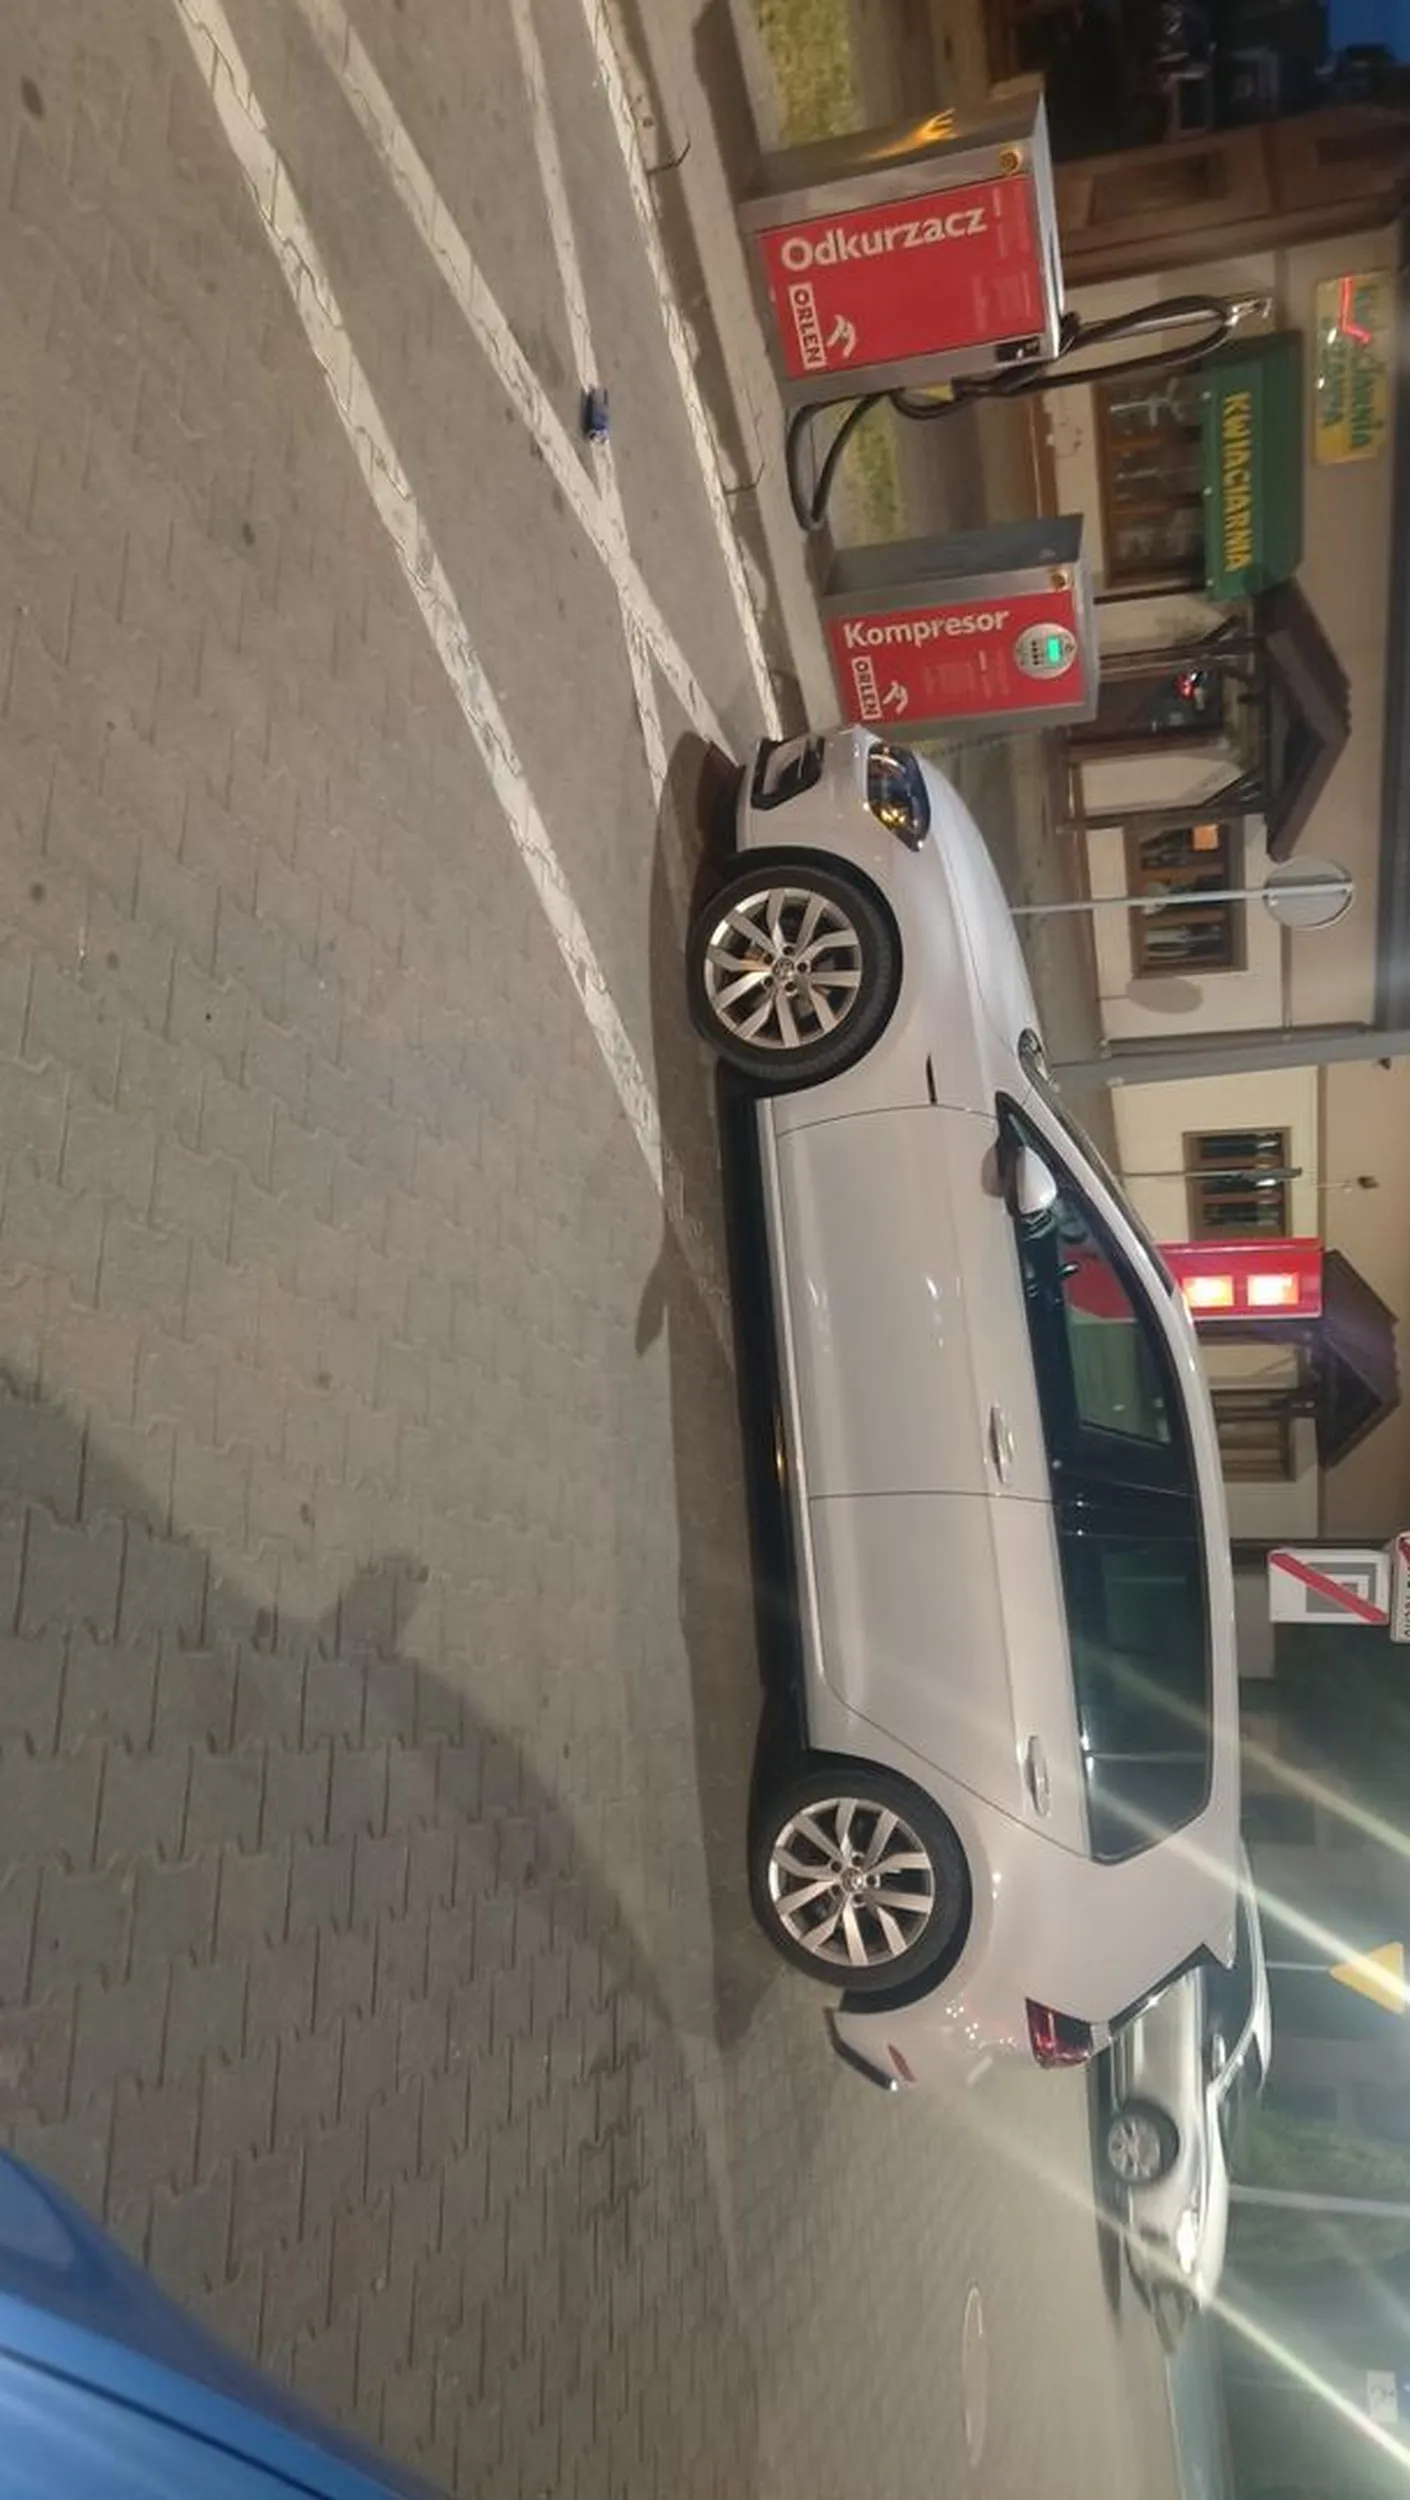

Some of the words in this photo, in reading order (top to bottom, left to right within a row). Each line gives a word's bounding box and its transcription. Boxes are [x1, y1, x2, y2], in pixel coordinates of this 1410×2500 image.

[780, 207, 988, 271] Odkurzacz
[794, 289, 824, 364] ORLEN
[1222, 392, 1253, 572] KWIACIARNIA
[843, 610, 1009, 648] Kompresor
[855, 660, 879, 716] ORLEN
